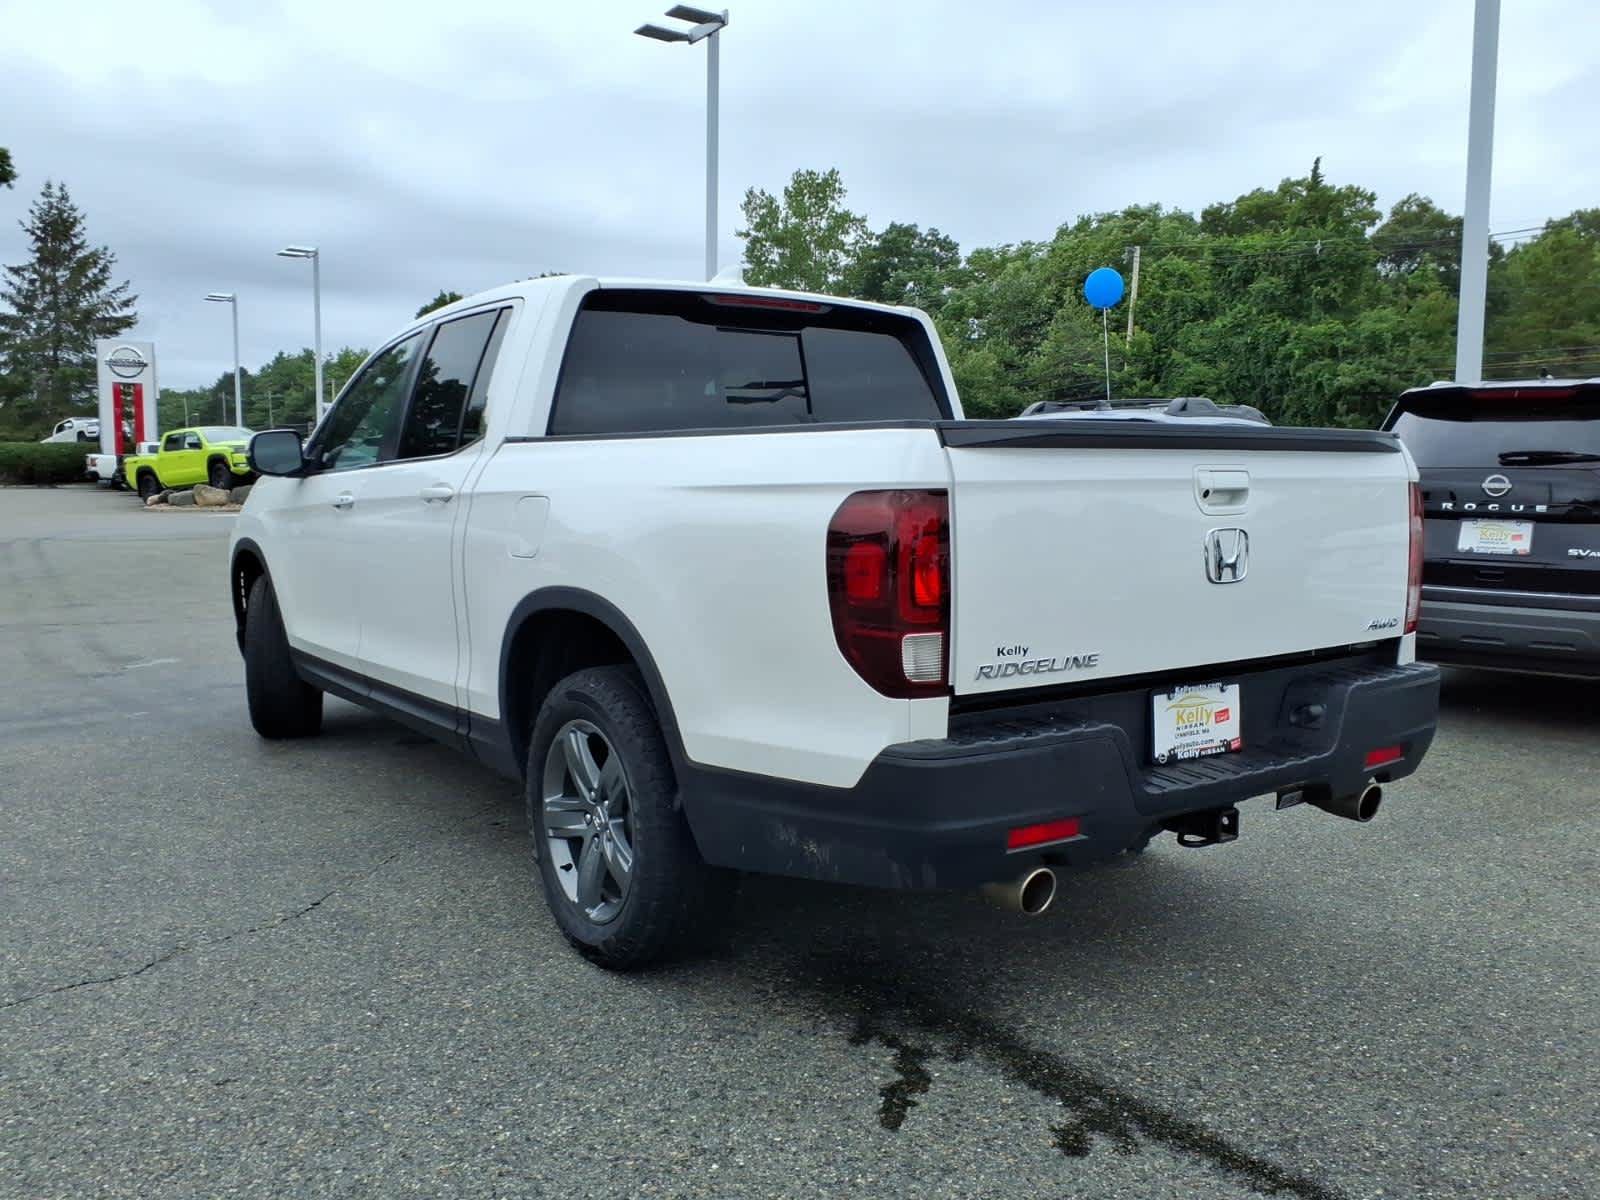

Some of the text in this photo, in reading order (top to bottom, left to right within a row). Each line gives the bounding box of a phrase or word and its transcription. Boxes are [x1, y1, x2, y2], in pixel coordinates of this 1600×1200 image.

[1441, 502, 1548, 513] ROGUE
[1367, 618, 1398, 631] AWD
[997, 645, 1029, 657] Kelly
[975, 653, 1099, 681] RIDGELINE
[1176, 706, 1213, 726] Kelly
[1176, 722, 1204, 731] NISSAN
[1177, 750, 1200, 760] Kelly
